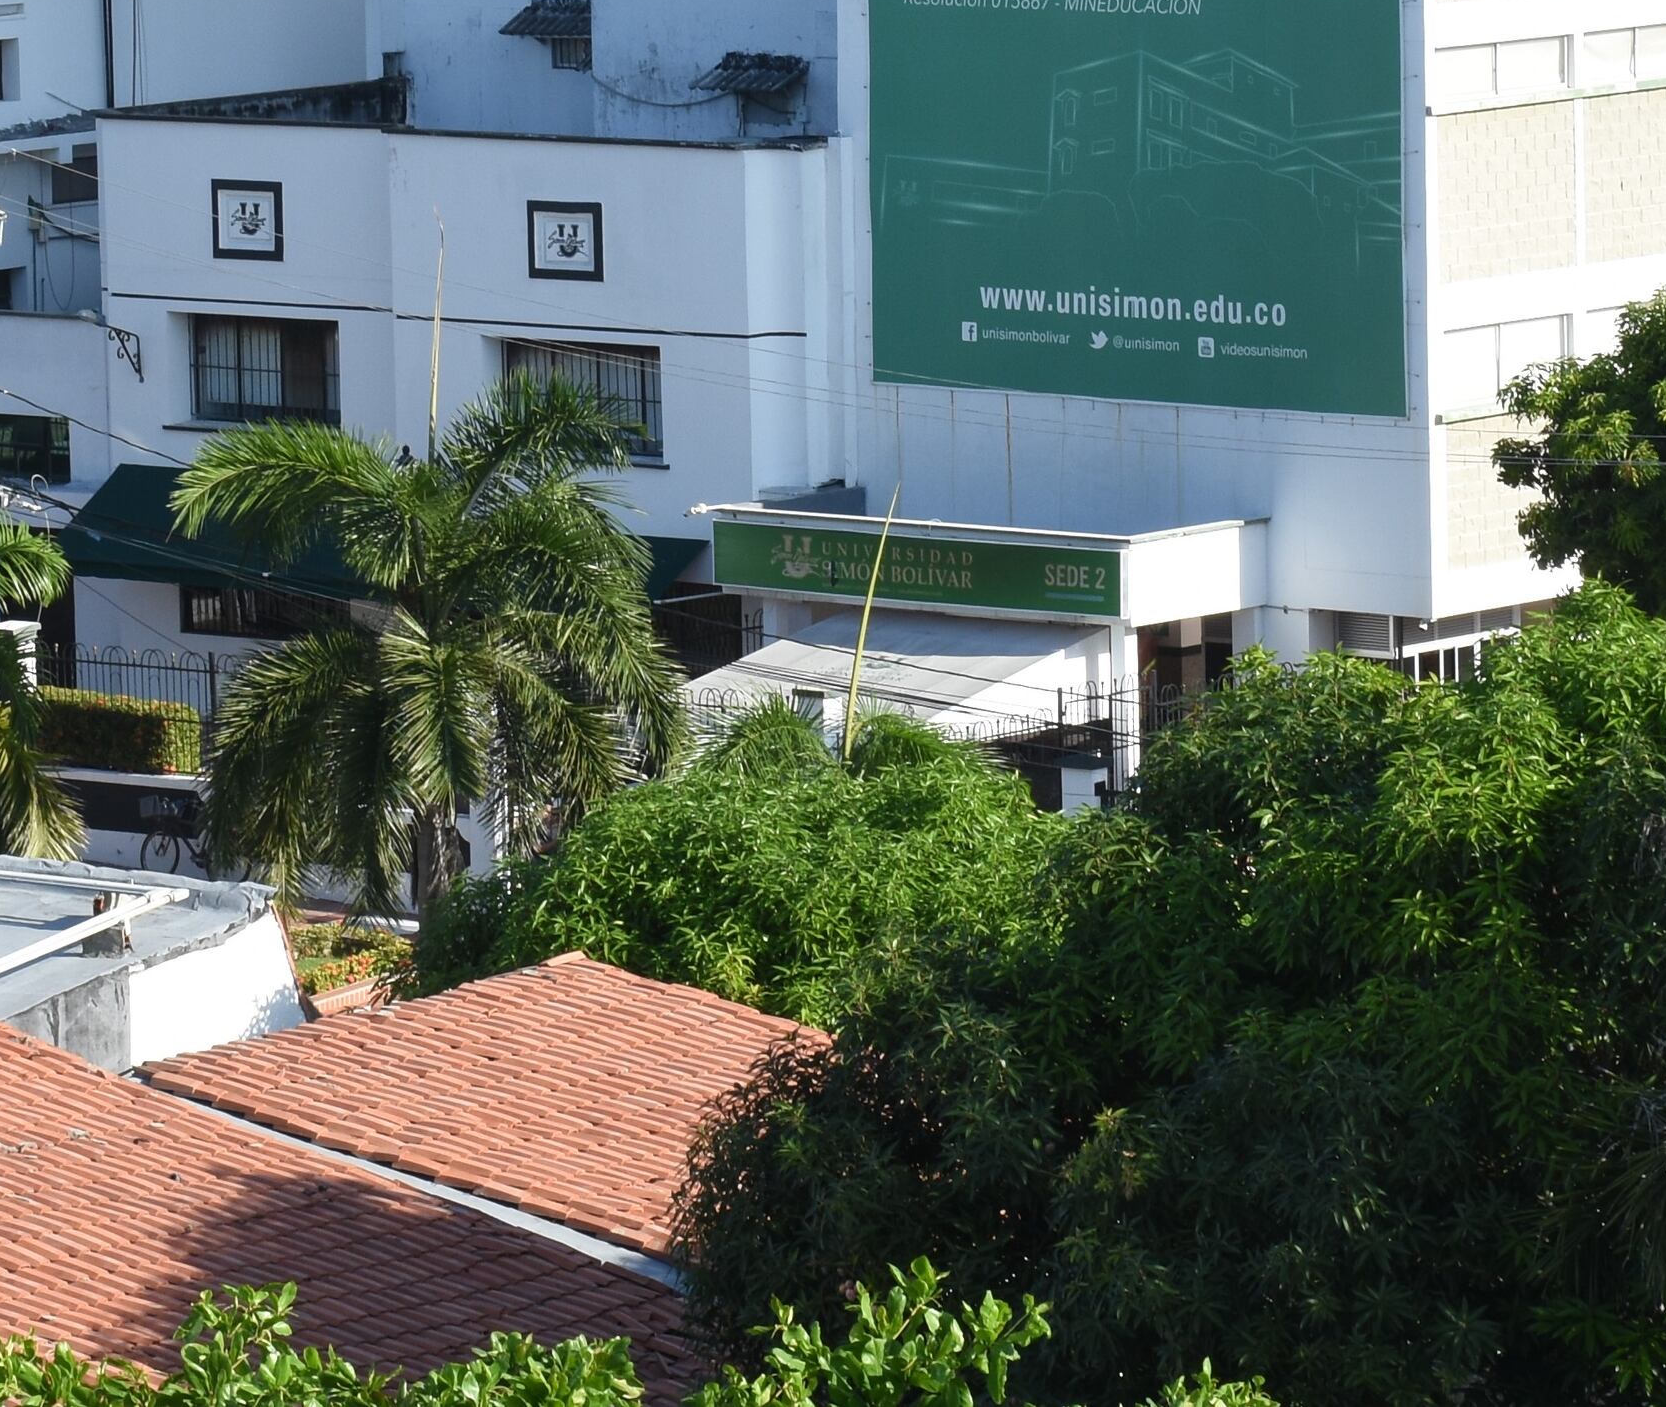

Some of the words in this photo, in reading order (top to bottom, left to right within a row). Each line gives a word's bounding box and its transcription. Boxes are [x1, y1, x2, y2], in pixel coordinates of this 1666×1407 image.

[980, 285, 1287, 326] www.unisimon.edu.co
[982, 326, 1071, 345] unisimonbolivar
[1113, 335, 1180, 352] @unisimon
[1220, 343, 1309, 360] videosunisimon
[821, 541, 973, 566] UNIVRSIDAD
[891, 564, 973, 589] BOLÍVAR
[1044, 563, 1091, 588] SEDE
[1095, 567, 1106, 590] 2
